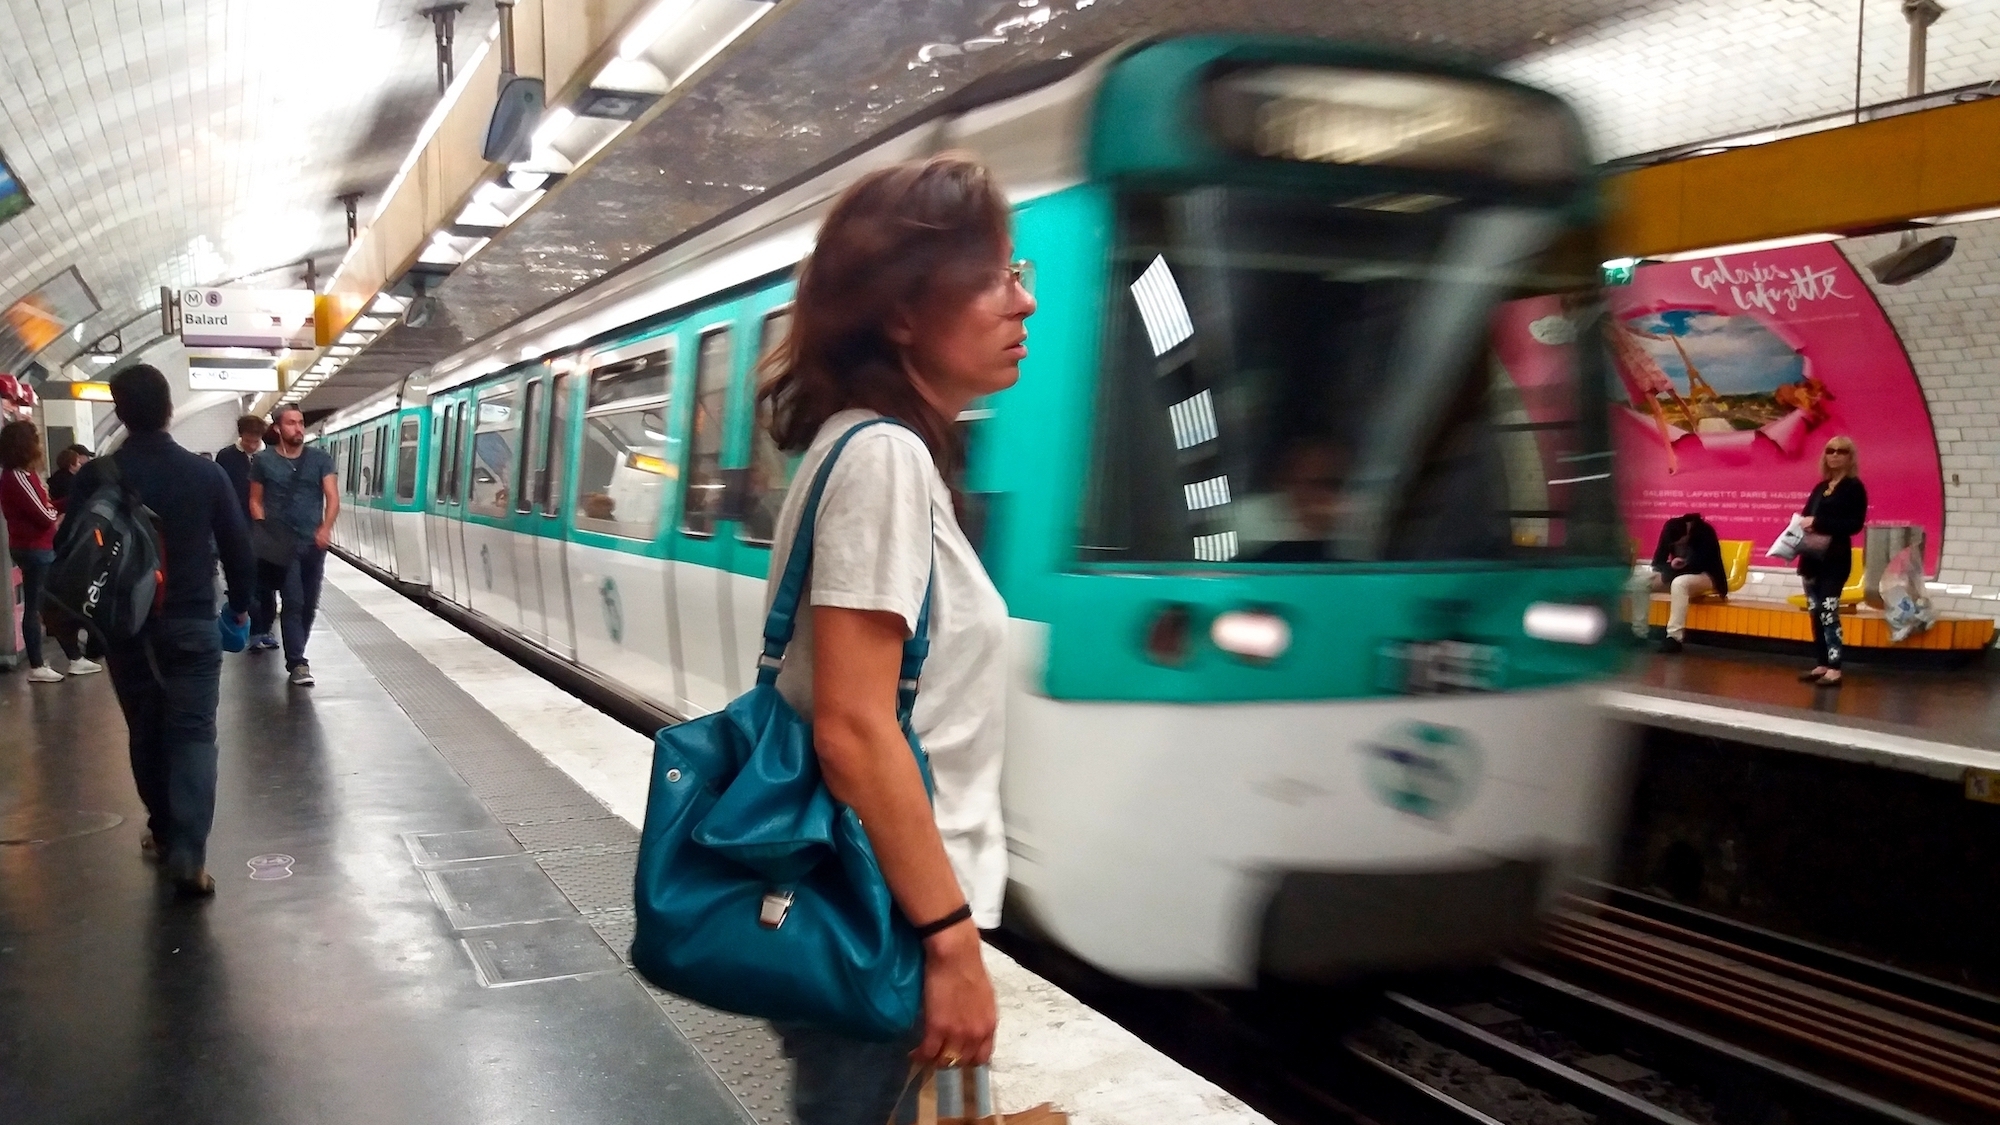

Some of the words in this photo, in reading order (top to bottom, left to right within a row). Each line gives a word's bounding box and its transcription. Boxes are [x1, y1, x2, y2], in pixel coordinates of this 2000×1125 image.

[1690, 256, 1788, 294] Galeries
[1731, 265, 1854, 315] Lafayette
[185, 313, 228, 326] Balard
[1642, 490, 1684, 498] GALERIES
[1740, 490, 1767, 499] PARIS
[1770, 491, 1811, 499] HAUSSM
